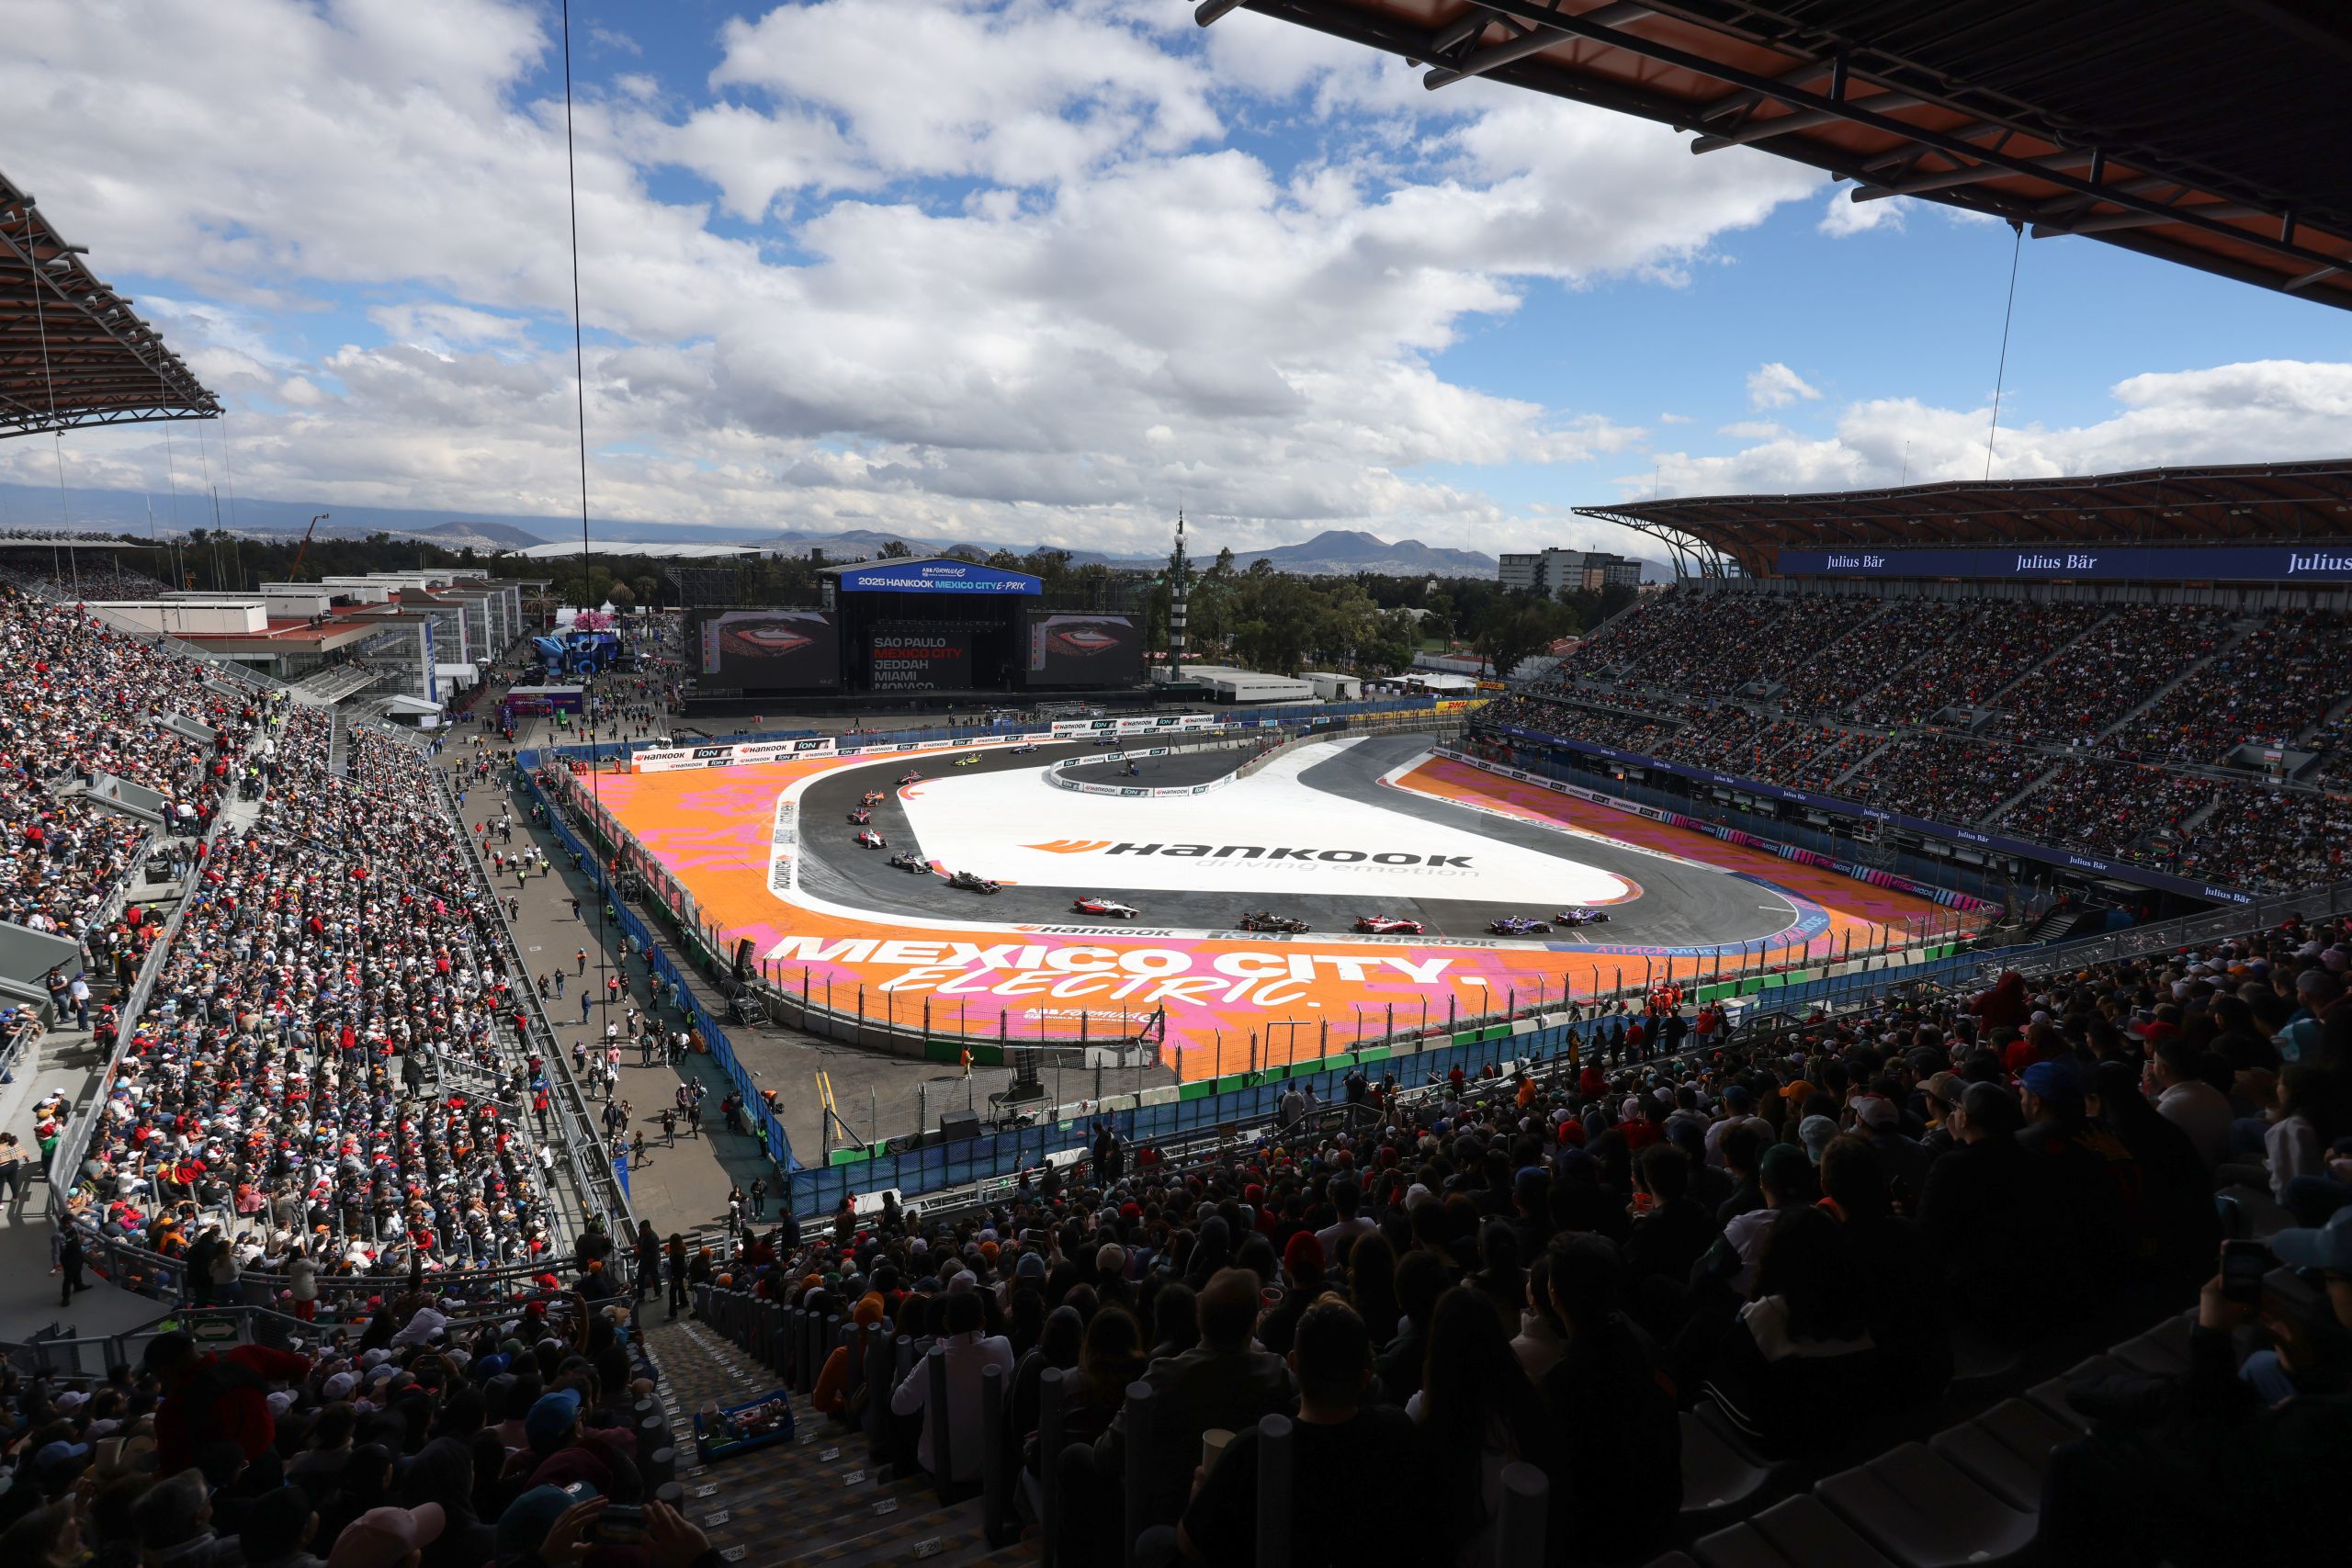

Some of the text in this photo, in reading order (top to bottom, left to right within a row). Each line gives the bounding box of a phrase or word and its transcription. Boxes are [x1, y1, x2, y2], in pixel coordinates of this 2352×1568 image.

[1826, 555, 1885, 569] Julius Bär
[2016, 553, 2098, 570] Julius Bär
[858, 577, 1026, 591] 2025 HANKOOK MEXICO CITY E-PRIX
[875, 637, 946, 648] SÃO PAULO
[875, 649, 962, 659] MEXICO CITY
[875, 660, 929, 670] JEDDAH
[875, 671, 917, 681] MIAMI
[1783, 790, 1806, 801] Julius Bär
[1863, 808, 1890, 820] Julius Bär
[1958, 829, 1989, 843] Julius Bär
[1194, 858, 1481, 878] driving emotion
[2069, 855, 2108, 871] Julius Bär
[2205, 886, 2251, 905] Julius Bär
[764, 936, 1487, 986] MEXICO CITY.
[877, 964, 1321, 1008] ELECTRIC.
